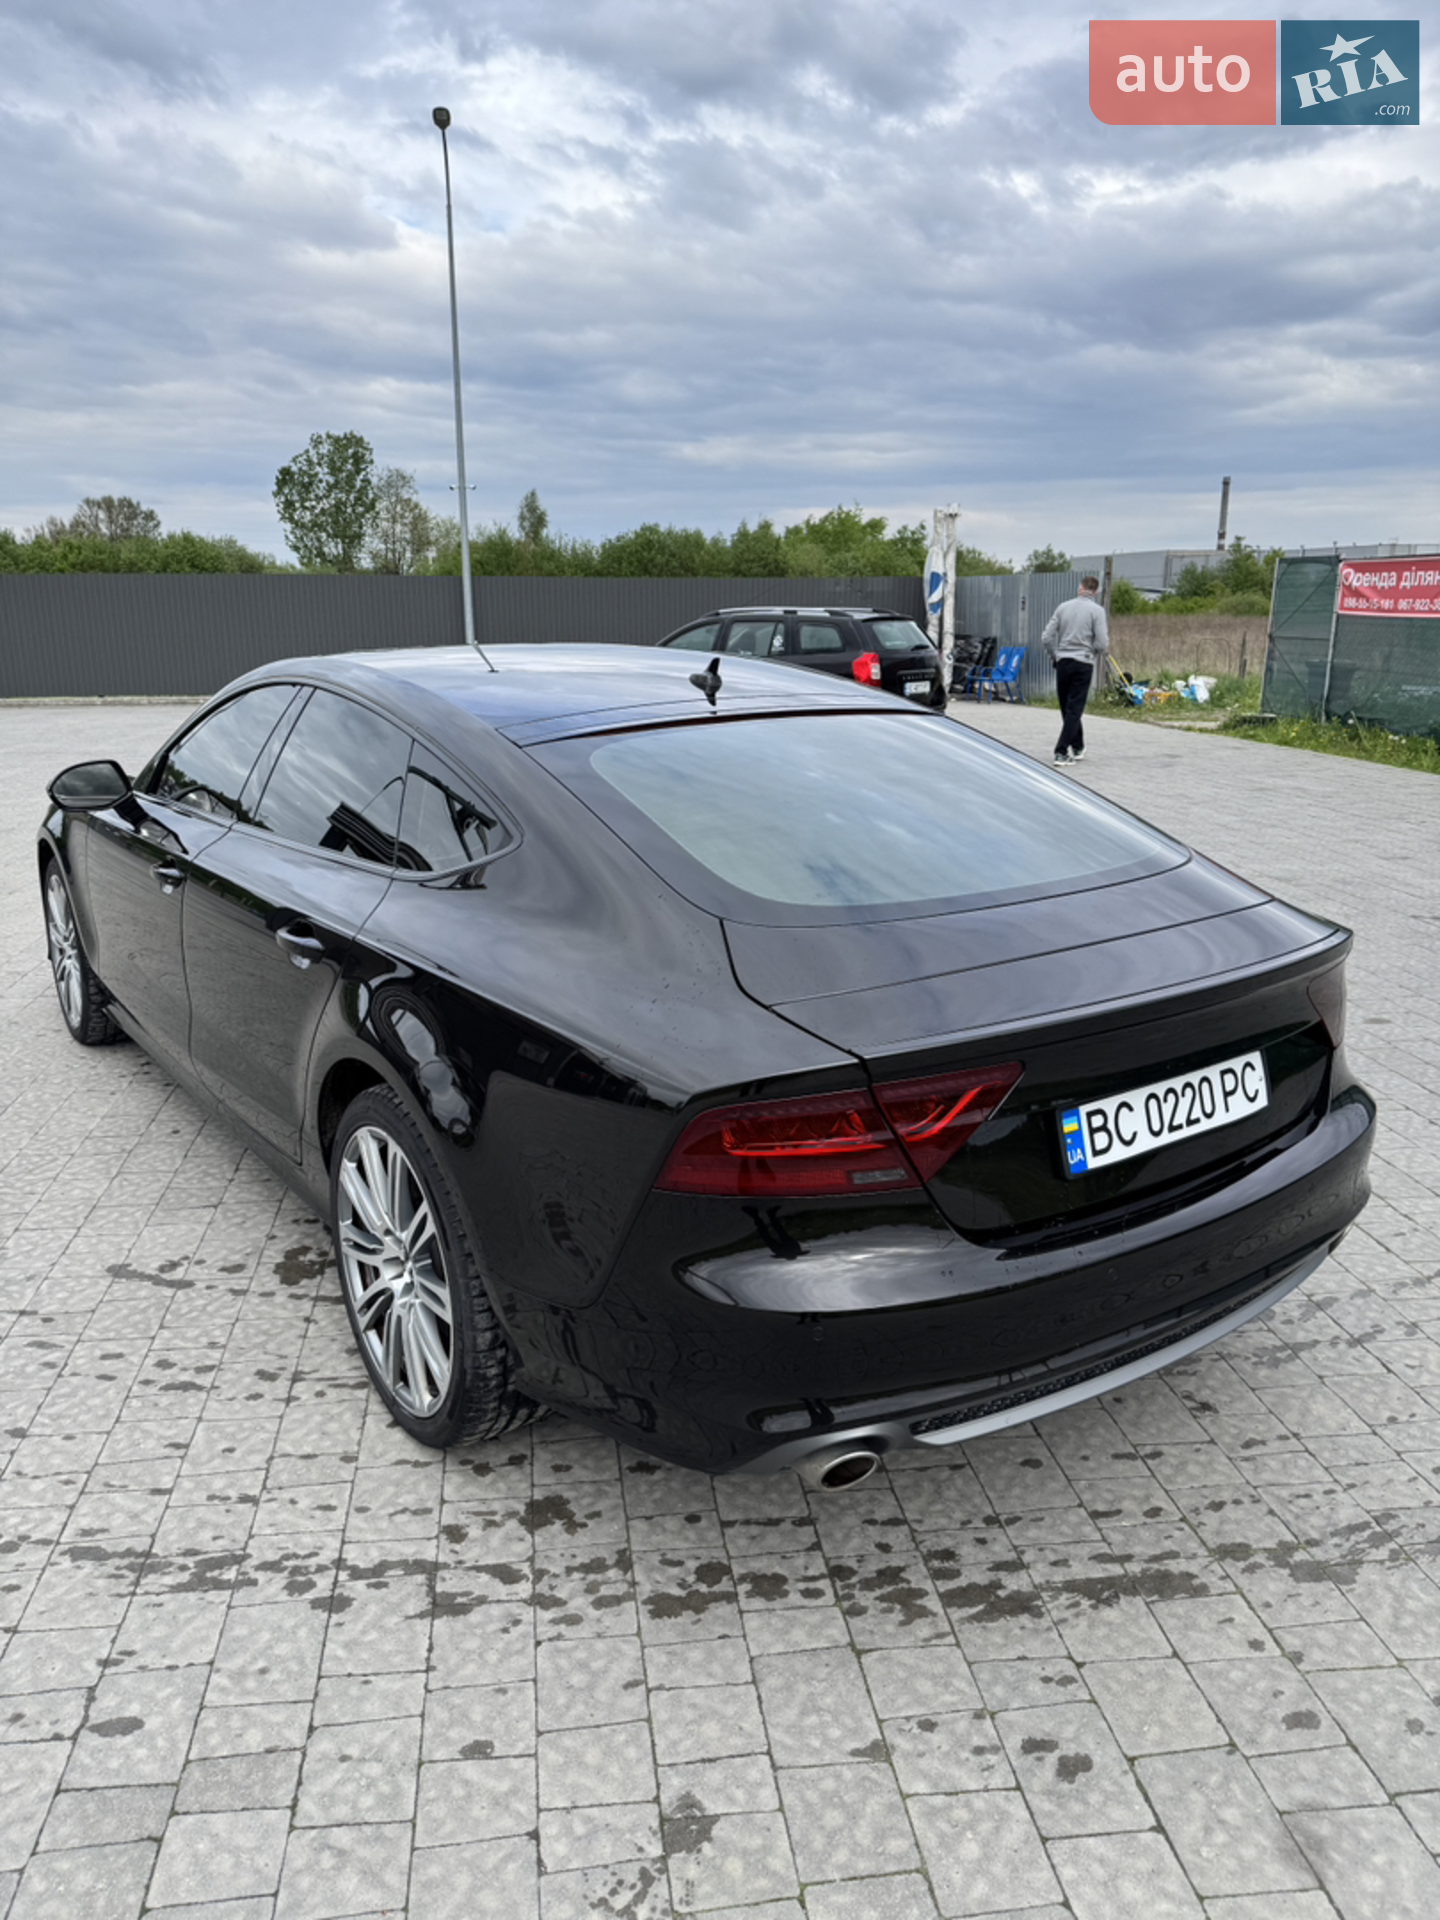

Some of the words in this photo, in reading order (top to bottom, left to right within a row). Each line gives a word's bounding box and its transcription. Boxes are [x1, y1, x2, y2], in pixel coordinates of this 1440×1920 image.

[1342, 568, 1398, 590] Оренда
[1086, 1101, 1138, 1157] BC
[1144, 1076, 1216, 1138] 0220
[1219, 1061, 1259, 1113] PC
[1066, 1148, 1085, 1165] UA
